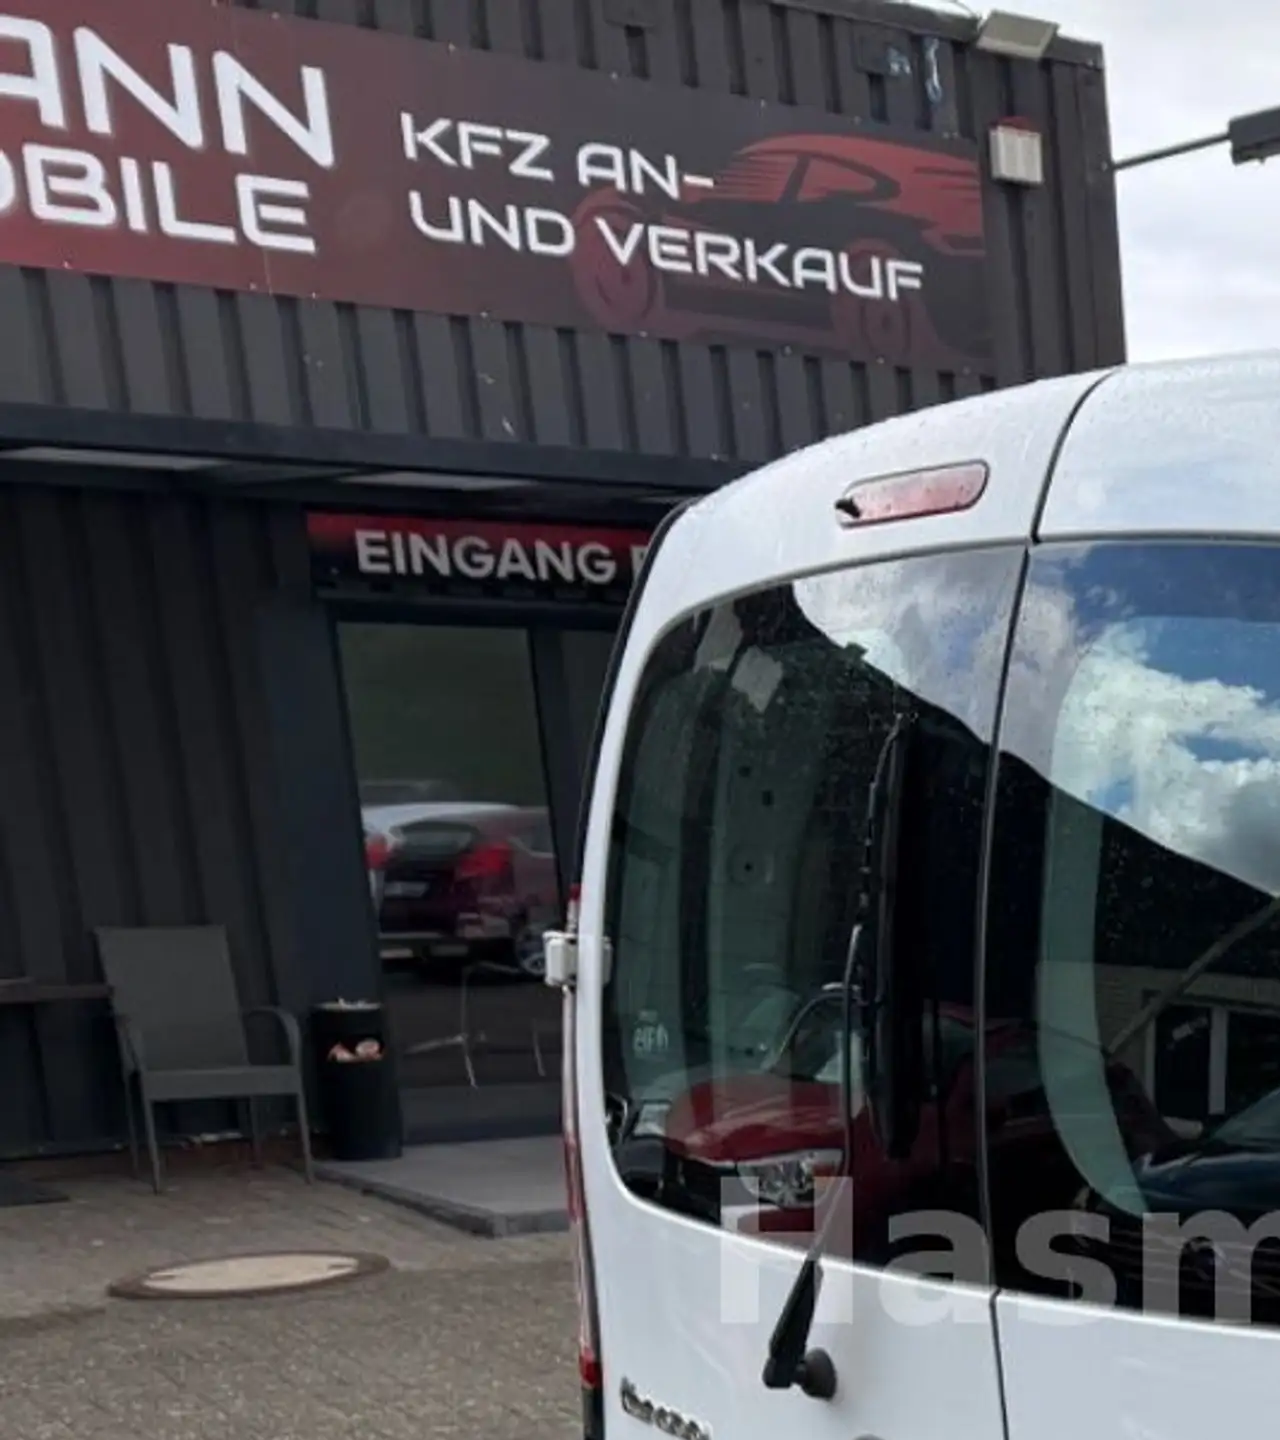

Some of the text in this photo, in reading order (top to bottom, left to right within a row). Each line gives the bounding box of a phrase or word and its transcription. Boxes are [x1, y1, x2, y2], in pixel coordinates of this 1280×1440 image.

[0, 143, 317, 253] BILE
[401, 112, 715, 200] KFZ AN-
[409, 190, 924, 301] UND VERKAUF
[355, 529, 617, 585] EINGANG
